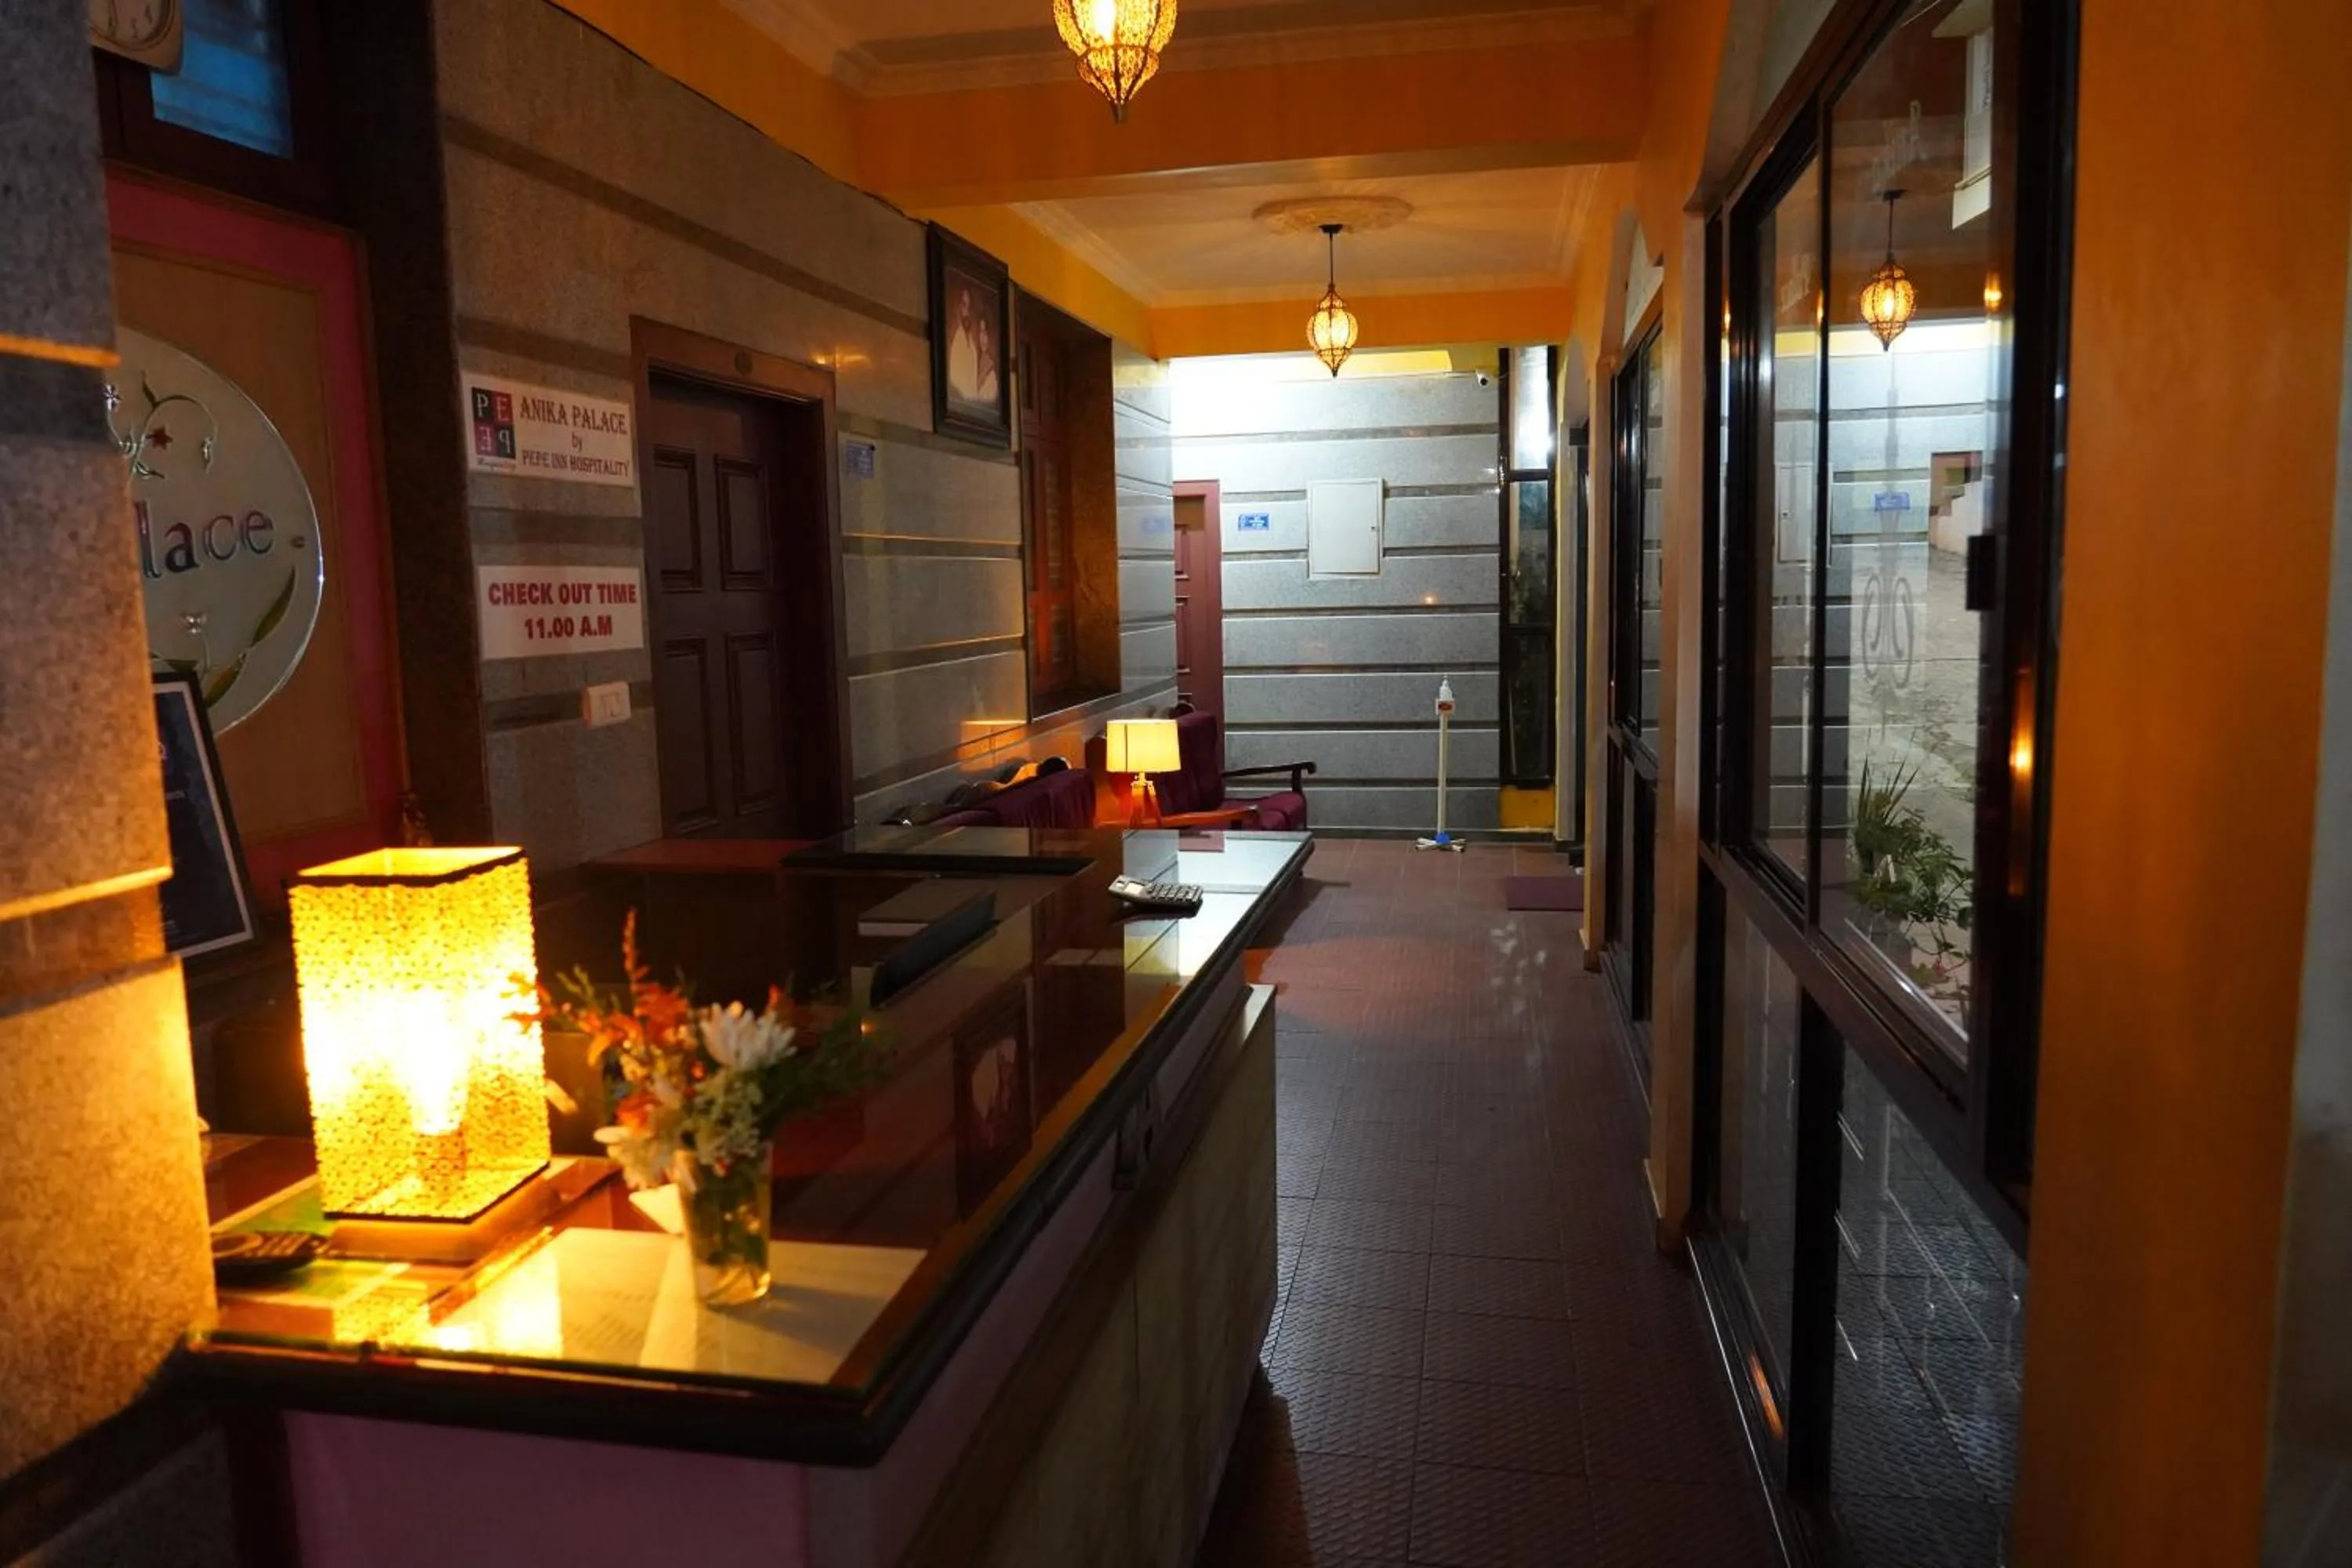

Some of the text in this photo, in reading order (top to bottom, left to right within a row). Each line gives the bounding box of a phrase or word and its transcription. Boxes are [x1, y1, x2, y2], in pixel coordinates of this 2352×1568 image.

[519, 397, 627, 434] ANIKA PALACE
[572, 433, 583, 452] by
[522, 450, 549, 468] PEPE
[552, 454, 567, 470] INN
[570, 456, 629, 477] HOSPITALITY
[488, 583, 637, 605] CHECK OUT TIME
[524, 615, 612, 640] 11.00 A.M
